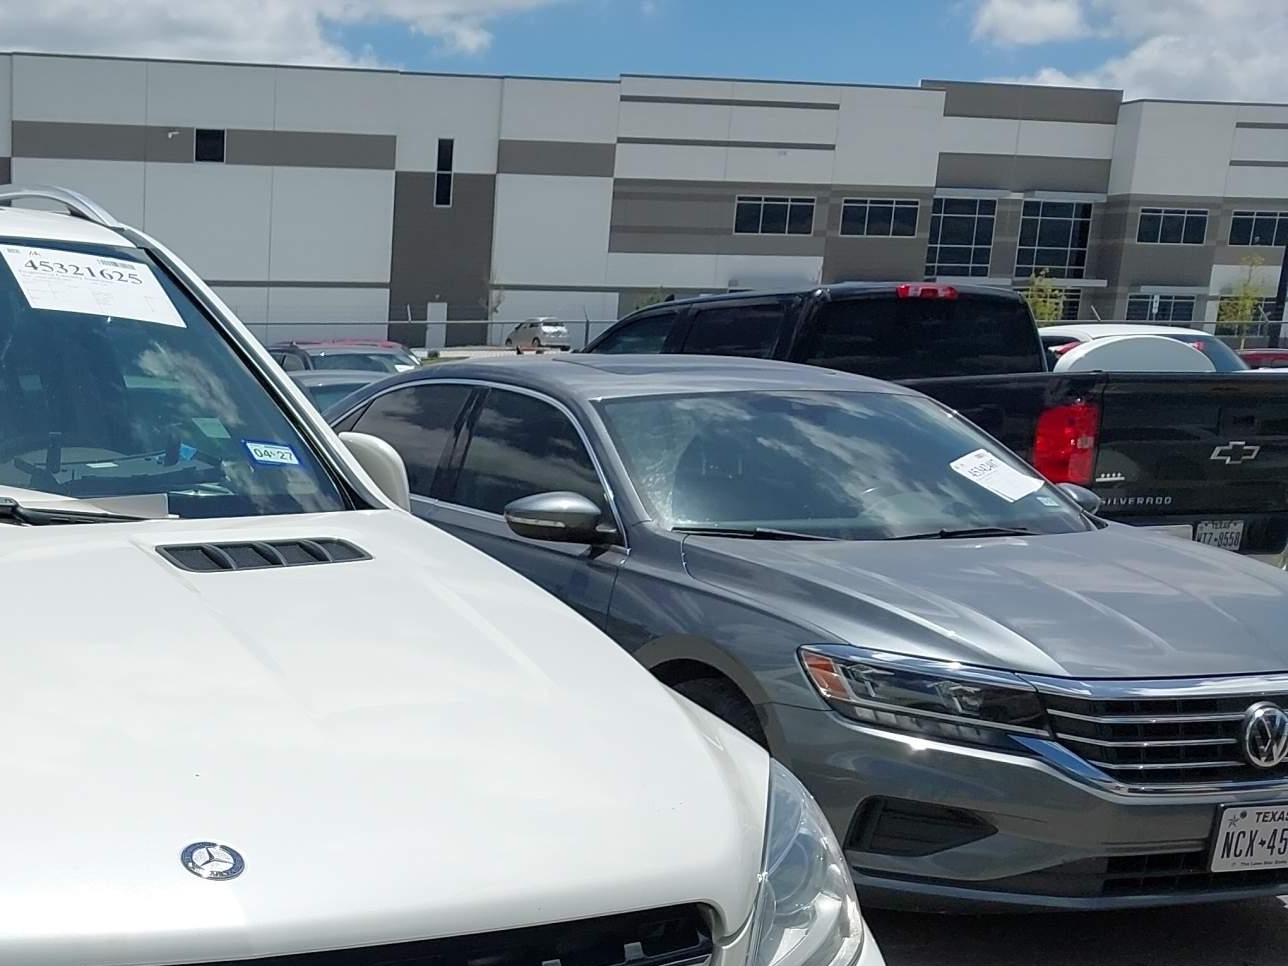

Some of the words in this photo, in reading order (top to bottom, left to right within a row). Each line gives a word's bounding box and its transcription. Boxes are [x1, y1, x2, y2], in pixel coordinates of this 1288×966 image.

[24, 259, 144, 285] 45321625
[253, 448, 272, 458] 04
[277, 450, 293, 461] 27
